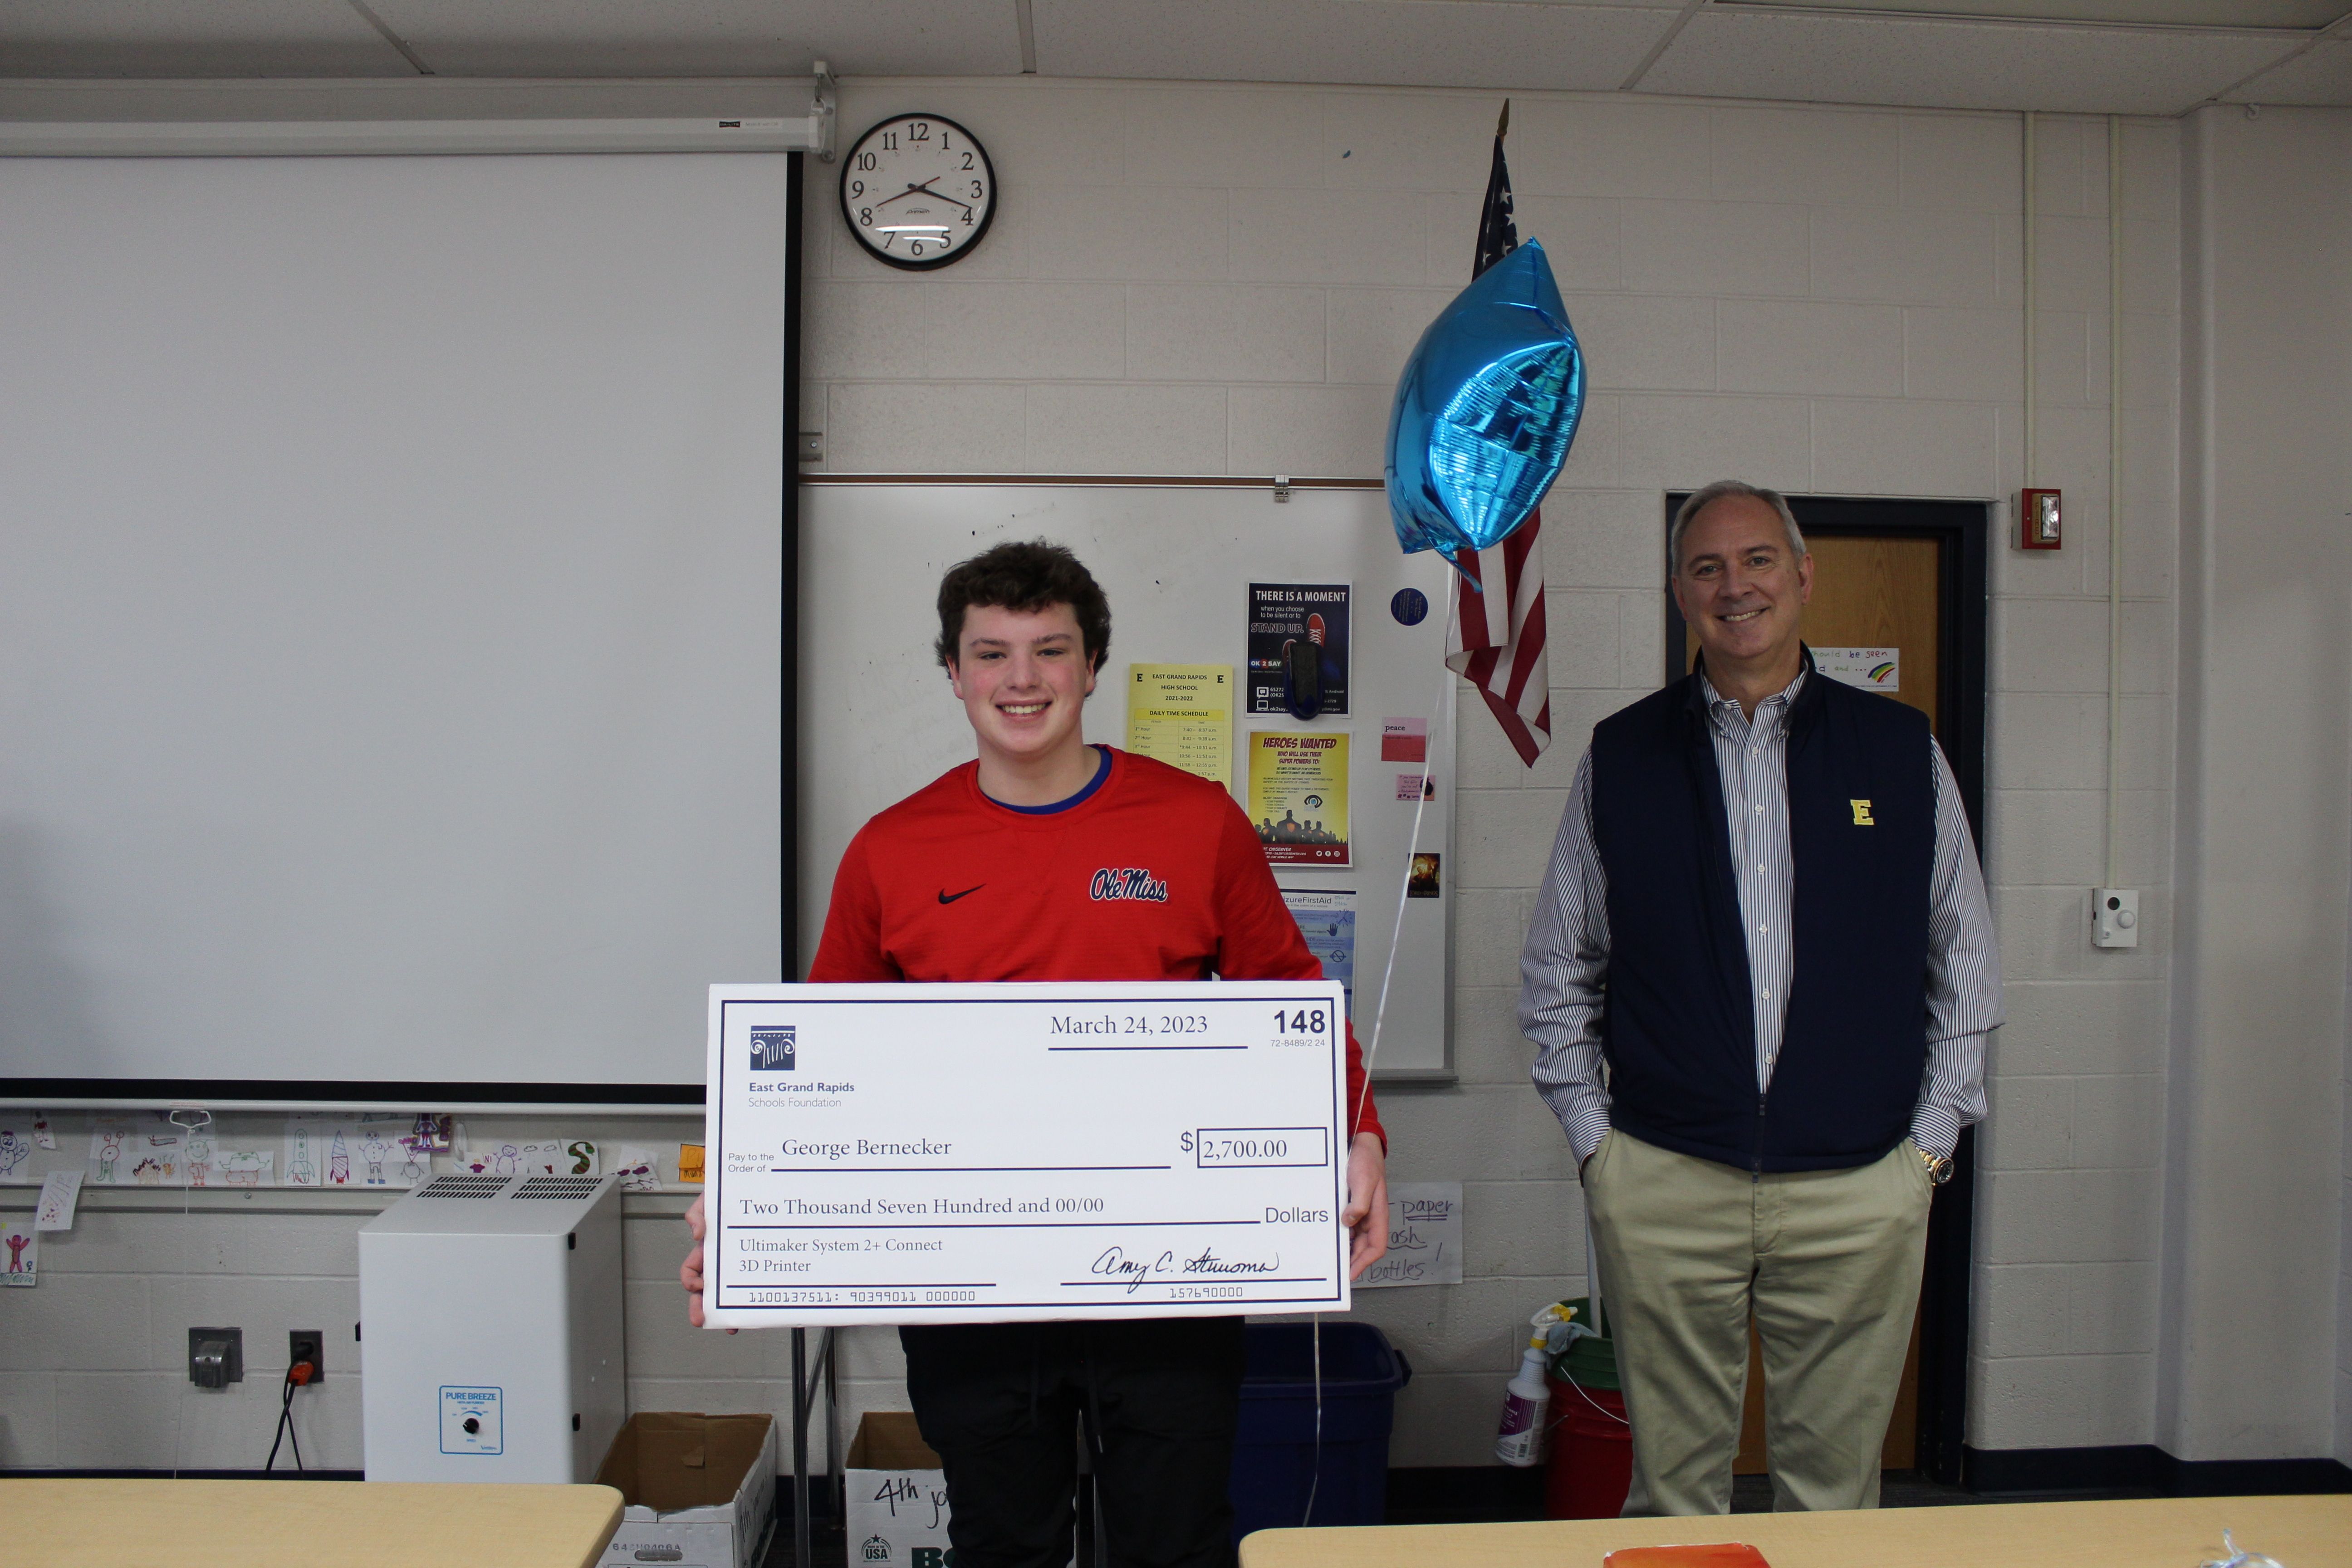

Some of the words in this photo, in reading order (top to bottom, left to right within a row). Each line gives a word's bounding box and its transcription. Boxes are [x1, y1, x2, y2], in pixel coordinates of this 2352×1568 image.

[908, 122, 930, 141] 12
[882, 132, 898, 150] 11
[941, 132, 950, 150] 1
[857, 152, 877, 171] 10
[961, 152, 974, 171] 2
[852, 180, 864, 199] 9
[971, 180, 983, 198] 3
[860, 207, 873, 226] 8
[960, 207, 974, 226] 4
[884, 231, 896, 249] 7
[911, 240, 923, 255] 6
[940, 230, 951, 249] 5
[1256, 590, 1284, 601] THERE
[1286, 591, 1294, 601] IS
[1296, 592, 1303, 601] A
[1305, 592, 1346, 602] MOMENT
[1251, 623, 1285, 632] STAND
[1287, 623, 1304, 633] UP.
[1137, 674, 1143, 682] E
[1217, 675, 1224, 683] E
[1263, 737, 1298, 748] HEROES
[1300, 738, 1337, 749] WANTED
[1850, 799, 1875, 825] E
[1090, 868, 1122, 901] Ole
[1121, 868, 1168, 903] Miss
[1050, 1015, 1117, 1034] March
[1123, 1016, 1154, 1036] 24,
[1160, 1015, 1208, 1034] 2023
[1273, 1009, 1326, 1034] 148
[749, 1083, 774, 1092] East
[777, 1083, 813, 1092] Grand
[817, 1083, 855, 1093] Rapids
[748, 1097, 785, 1107] Schools
[789, 1097, 842, 1107] Foundation
[782, 1139, 850, 1160] George
[857, 1138, 952, 1155] Bernecker
[1181, 1131, 1194, 1153] $
[1203, 1140, 1287, 1160] 2,700.00
[729, 1153, 745, 1162] Pay
[740, 1199, 779, 1215] Two
[783, 1198, 872, 1215] Thousand
[877, 1198, 927, 1214] Seven
[933, 1198, 1012, 1214] Hundred
[1018, 1198, 1050, 1213] and
[1055, 1197, 1104, 1214] 00/00
[1265, 1207, 1329, 1223] Dollars
[1401, 1200, 1453, 1225] paper
[1388, 1226, 1426, 1244] ash
[740, 1239, 808, 1252] Ultimaker
[812, 1239, 860, 1254] System
[863, 1240, 882, 1251] 2+
[885, 1239, 943, 1252] Connect
[739, 1260, 759, 1272] 3D
[763, 1259, 811, 1272] Printer
[1091, 1247, 1151, 1294] Amy
[1155, 1251, 1173, 1273] C.
[749, 1291, 840, 1303] 1100137511:
[850, 1291, 916, 1303] 90399011
[926, 1290, 976, 1302] 000000
[1170, 1287, 1243, 1298] 157690000
[874, 1477, 919, 1517] 4th
[925, 1485, 948, 1529] jo
[866, 1548, 888, 1559] USA
